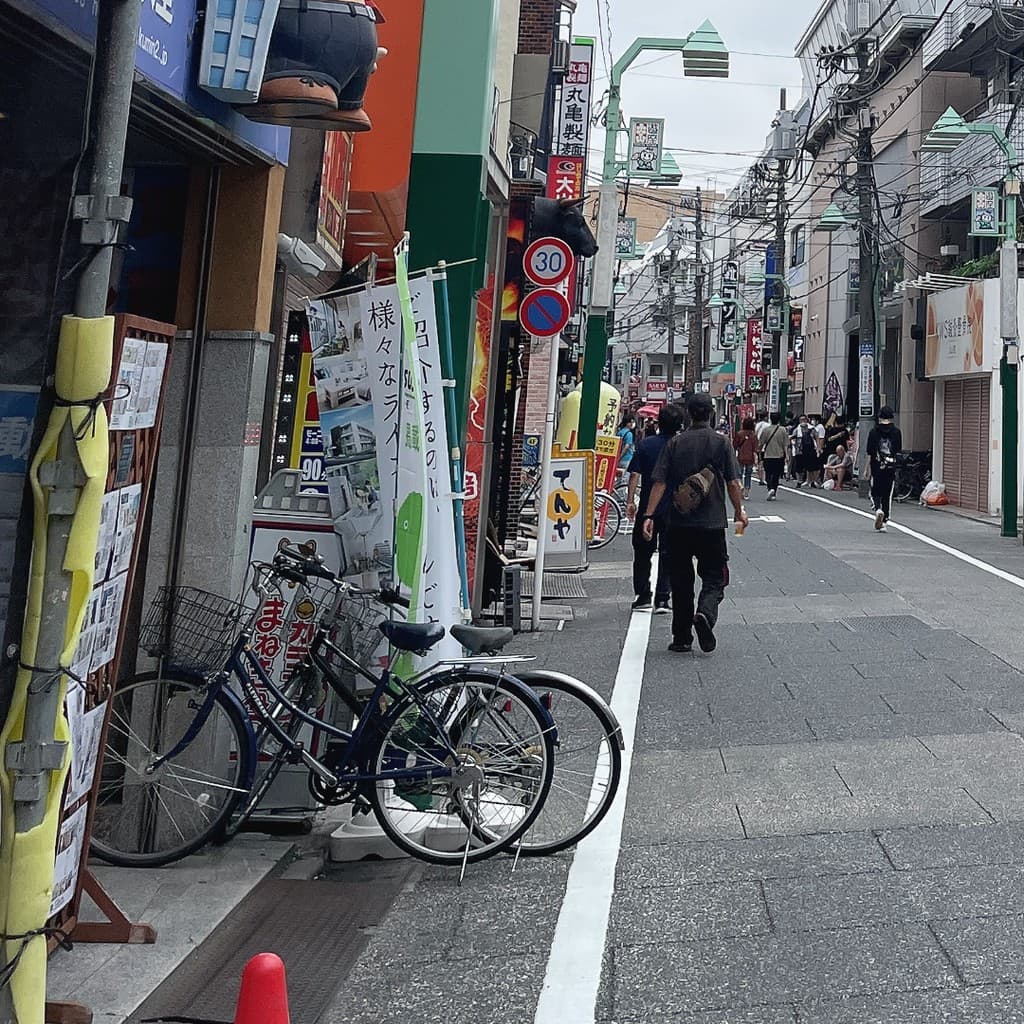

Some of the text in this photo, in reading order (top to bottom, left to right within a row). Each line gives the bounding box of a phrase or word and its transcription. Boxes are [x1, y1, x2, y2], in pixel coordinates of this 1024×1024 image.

[560, 87, 587, 156] 丸亀製麺
[535, 251, 562, 273] 30
[553, 469, 571, 540] てんや
